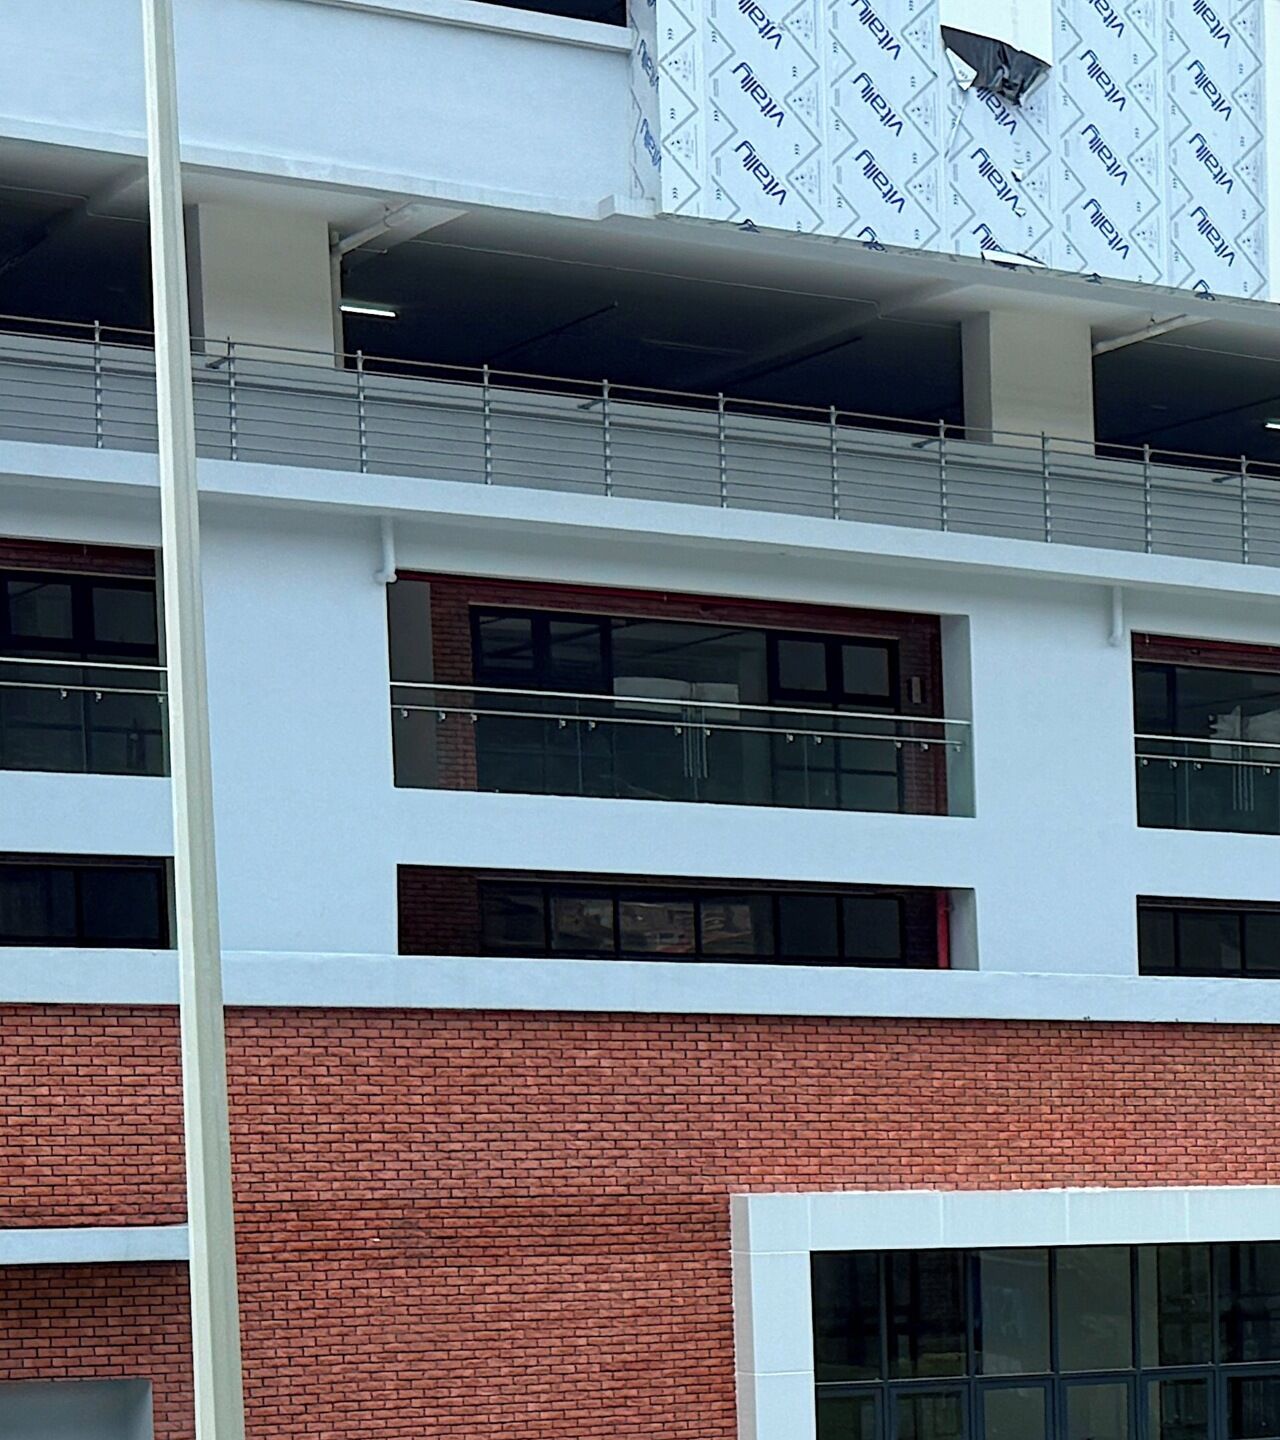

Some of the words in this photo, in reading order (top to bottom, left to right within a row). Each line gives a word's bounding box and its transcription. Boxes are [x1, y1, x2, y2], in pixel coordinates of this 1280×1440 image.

[732, 62, 784, 127] vitally
[853, 73, 903, 136] vitally
[1080, 50, 1125, 111] vitally
[1188, 60, 1233, 121] vitally
[735, 141, 786, 207] vitally
[855, 150, 905, 213] vitally
[971, 148, 1018, 209] vitally
[1081, 124, 1127, 188] vitally
[1189, 133, 1233, 194] vitally
[1083, 199, 1129, 261] vitally
[1190, 206, 1235, 267] vitally
